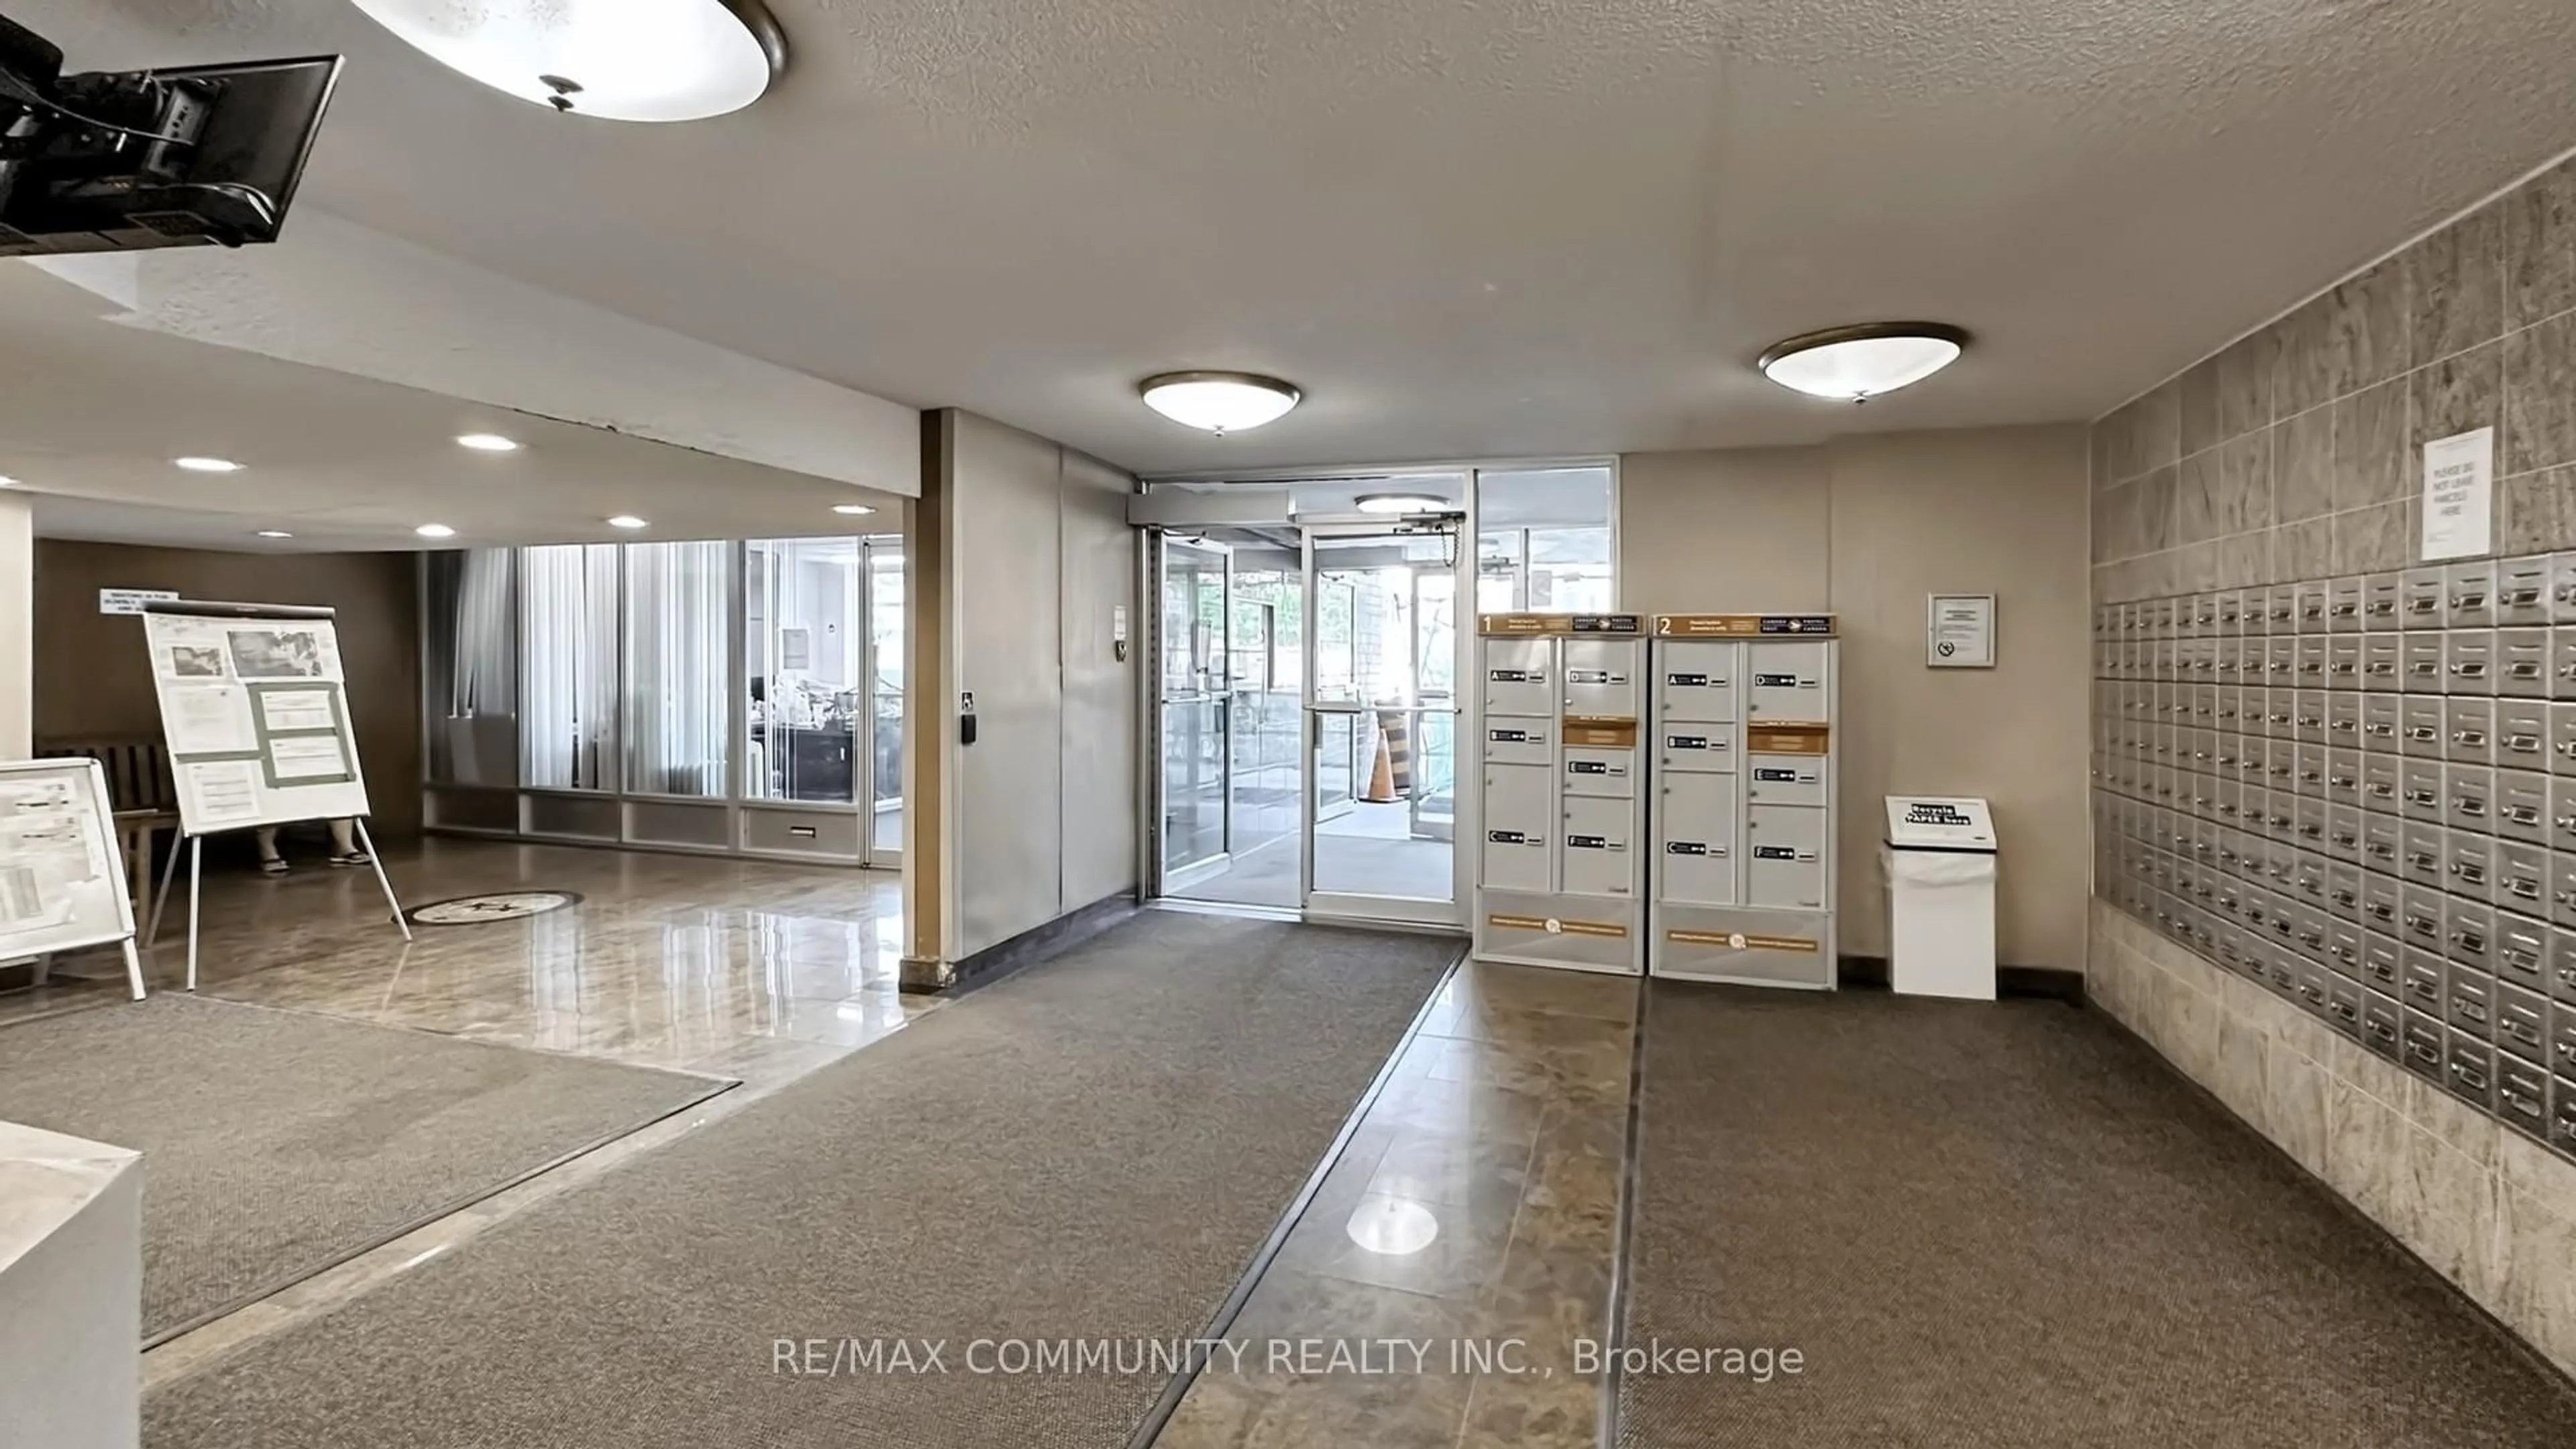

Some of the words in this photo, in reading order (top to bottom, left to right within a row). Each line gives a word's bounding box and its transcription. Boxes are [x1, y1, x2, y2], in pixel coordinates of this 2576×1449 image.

[1483, 615, 1492, 632] 1
[1660, 617, 1671, 635] 2
[1492, 672, 1499, 680] A
[1669, 676, 1676, 684] A
[1756, 676, 1765, 685] D
[1757, 770, 1764, 780] E
[1490, 832, 1497, 841] C
[1668, 843, 1676, 853] C
